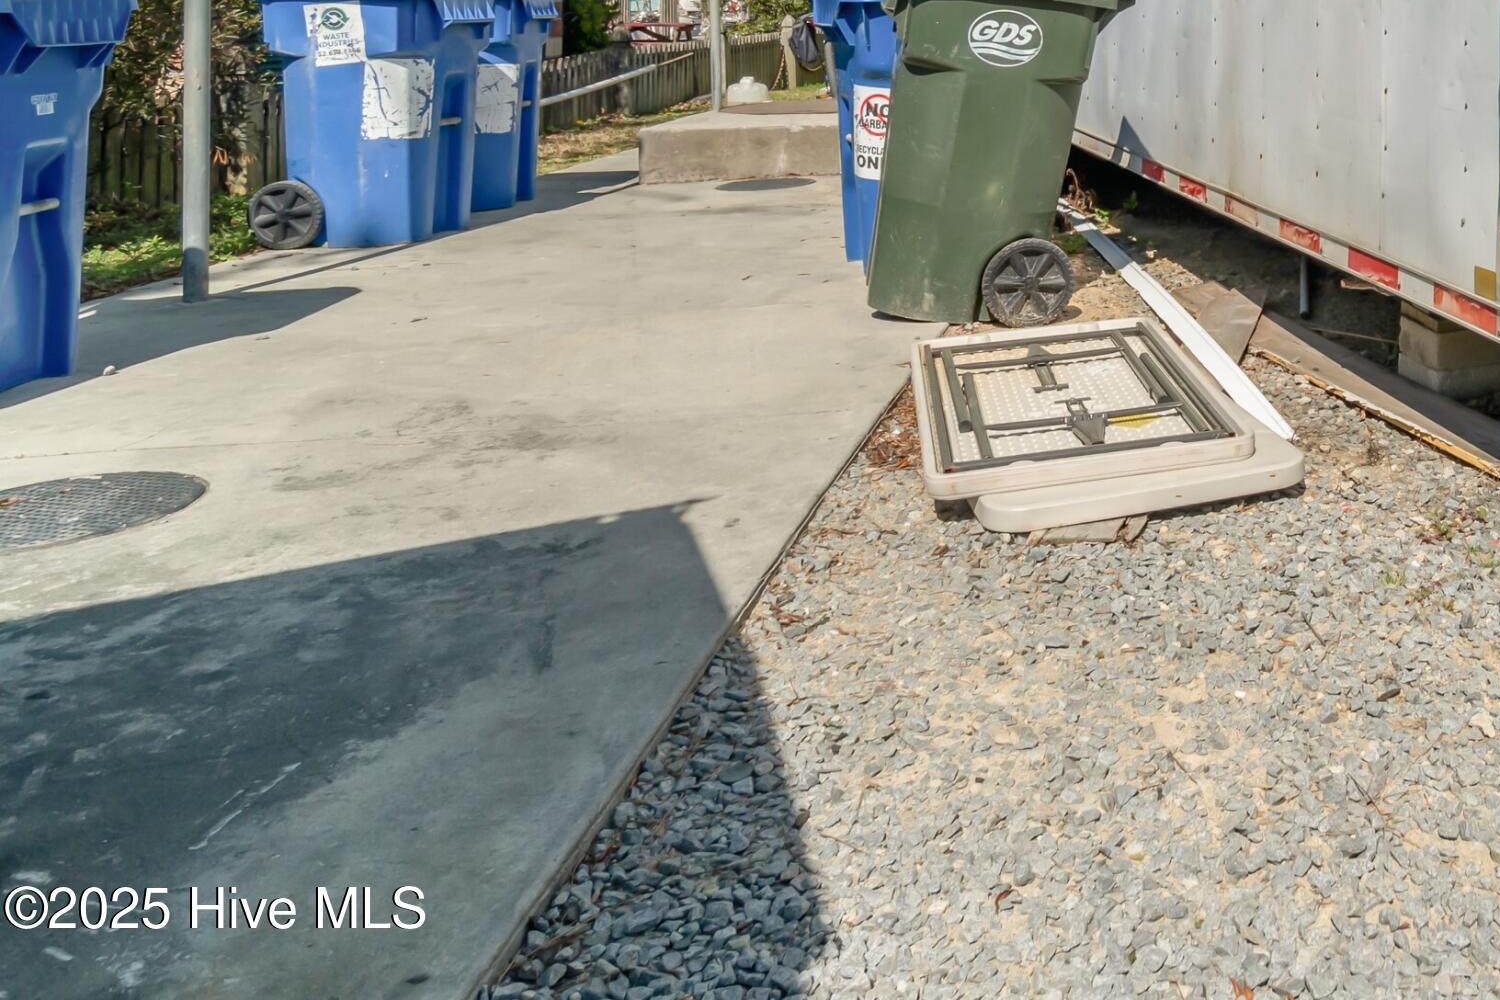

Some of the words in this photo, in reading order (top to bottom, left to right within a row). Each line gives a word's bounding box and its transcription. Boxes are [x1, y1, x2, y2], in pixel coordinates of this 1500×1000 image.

[323, 32, 350, 40] WASTE
[972, 19, 1037, 46] GDS
[857, 155, 879, 170] ON
